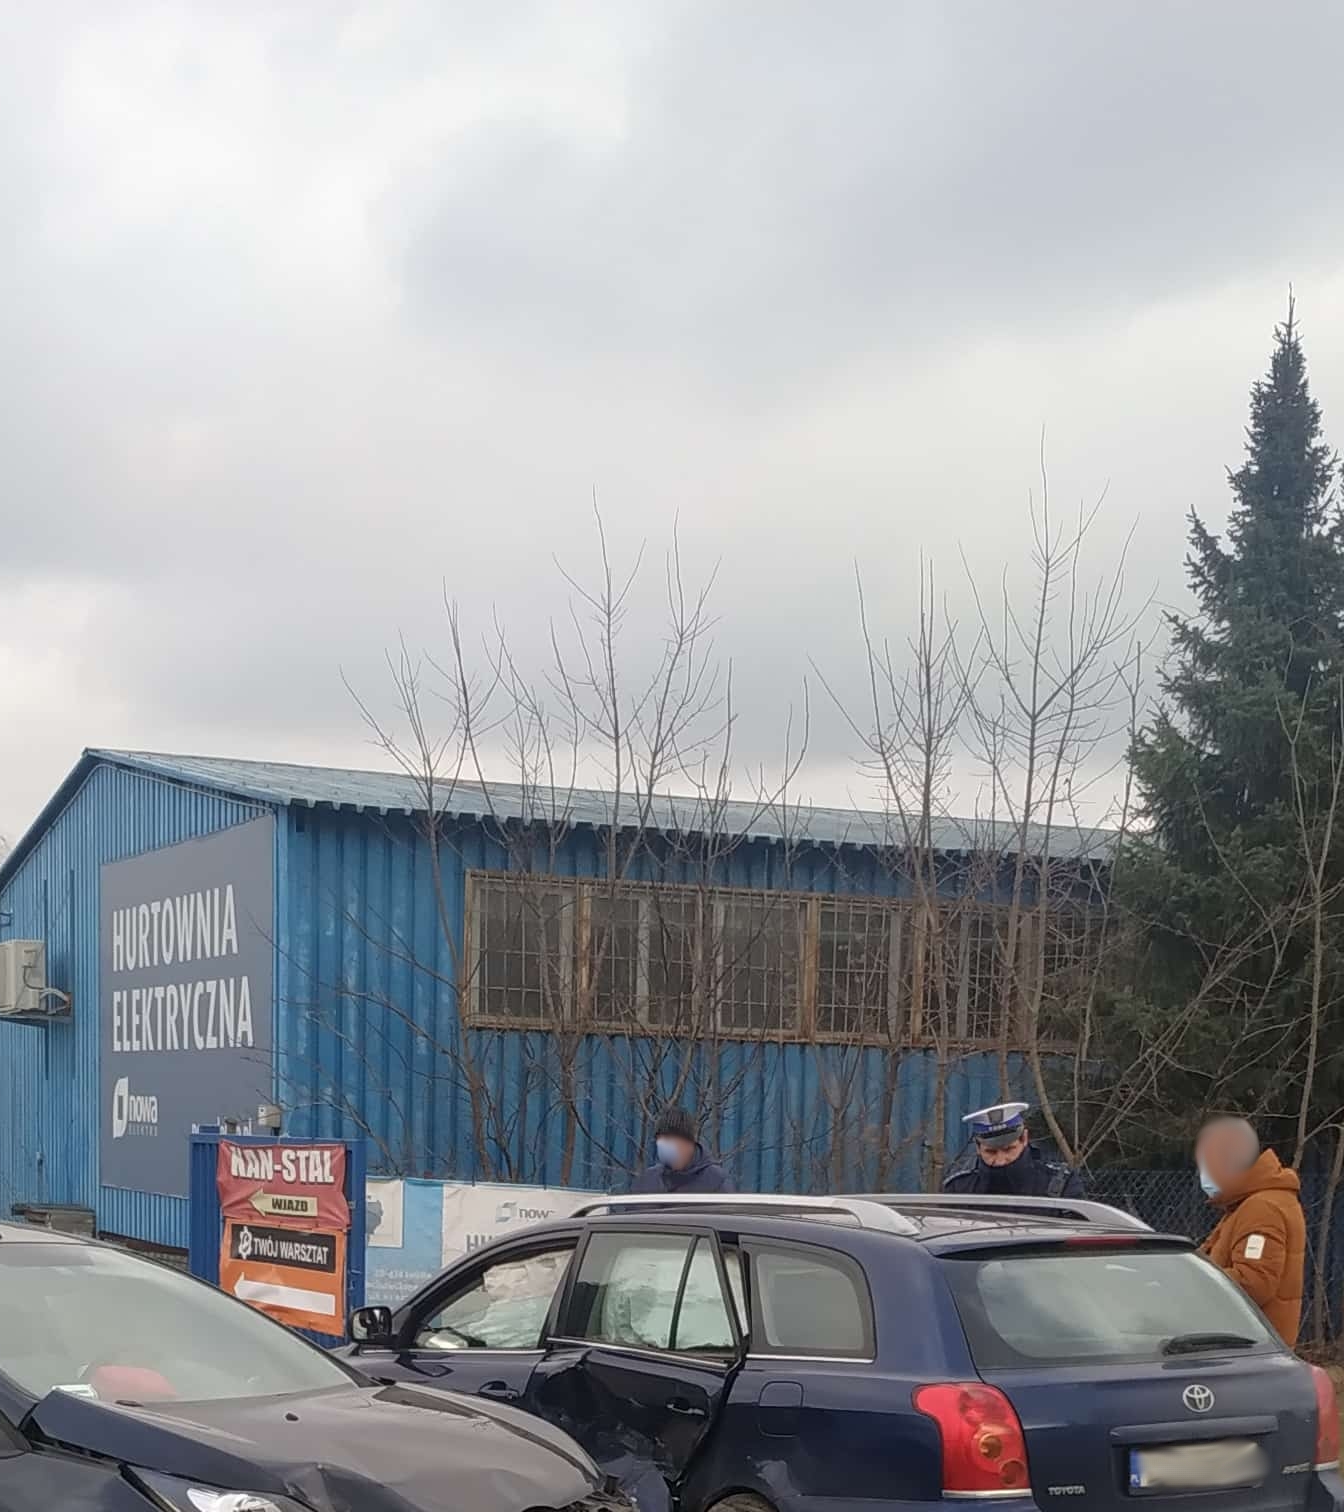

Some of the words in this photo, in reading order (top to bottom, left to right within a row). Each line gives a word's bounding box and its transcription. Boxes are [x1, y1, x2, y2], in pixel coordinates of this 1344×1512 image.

[112, 884, 238, 972] HURTOWNIA
[112, 976, 254, 1052] ELEKTRYCZNA
[128, 1095, 158, 1123] nowa
[229, 1146, 335, 1184] KAN-STAL
[271, 1197, 308, 1212] WJAZD
[253, 1234, 280, 1258] TWÓJ
[279, 1242, 329, 1265] WARSZTAT
[1047, 1485, 1086, 1496] TOYOTA
